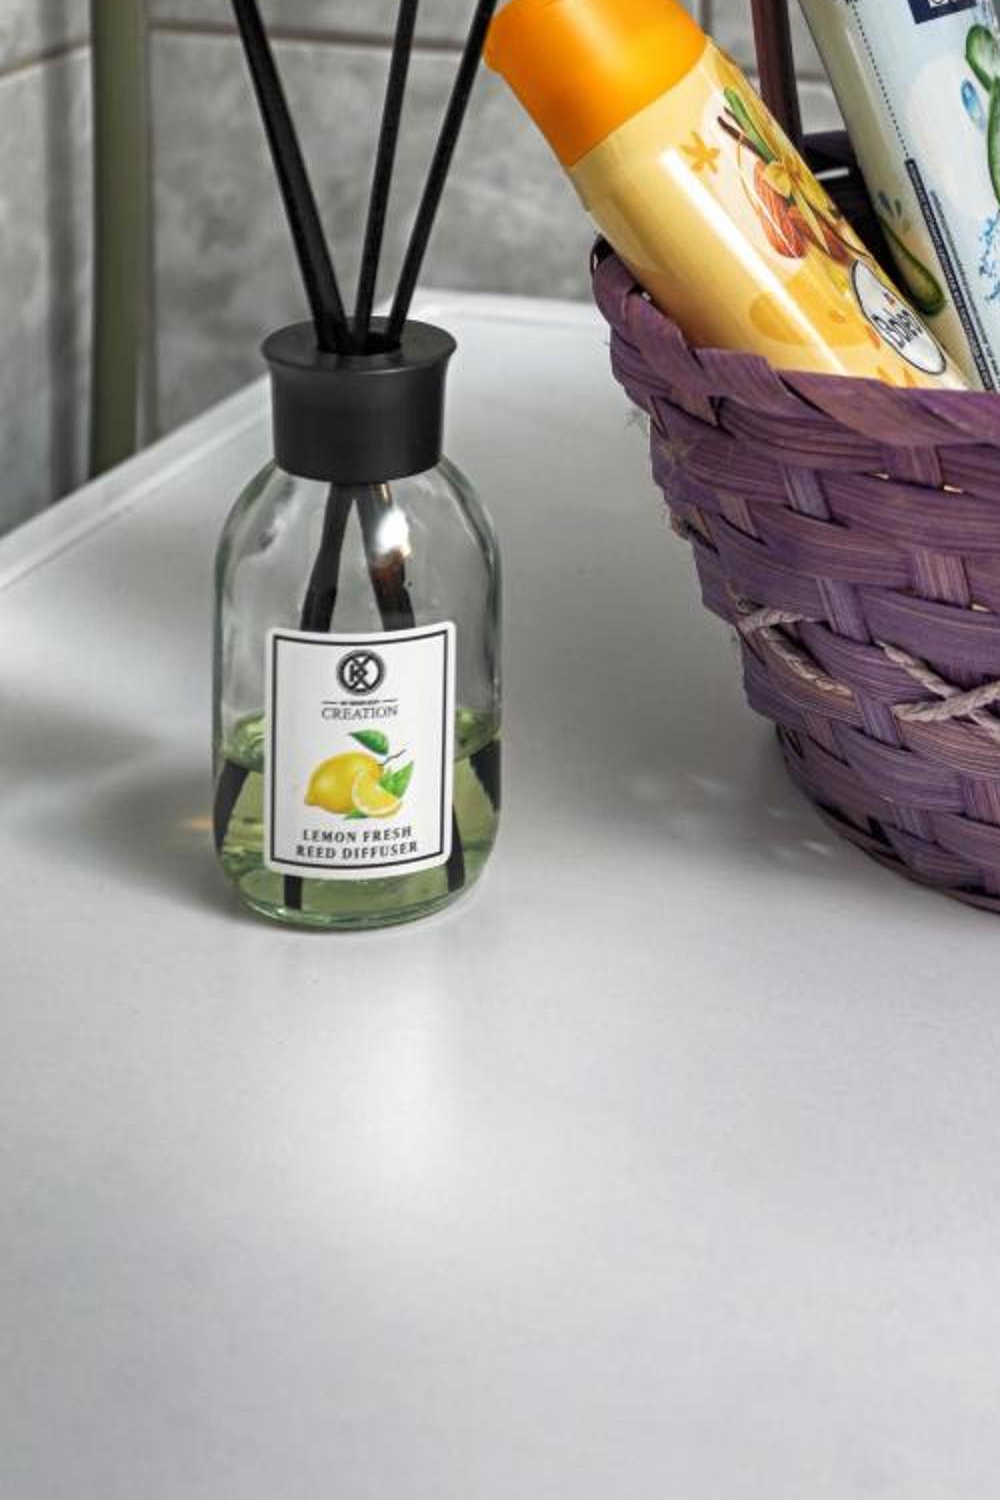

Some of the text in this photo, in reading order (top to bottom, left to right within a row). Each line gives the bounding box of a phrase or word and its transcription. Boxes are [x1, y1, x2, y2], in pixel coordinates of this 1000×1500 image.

[321, 705, 399, 720] CREATION
[303, 825, 411, 842] LEMON FRESH
[296, 841, 417, 860] REED DIFFUSER
